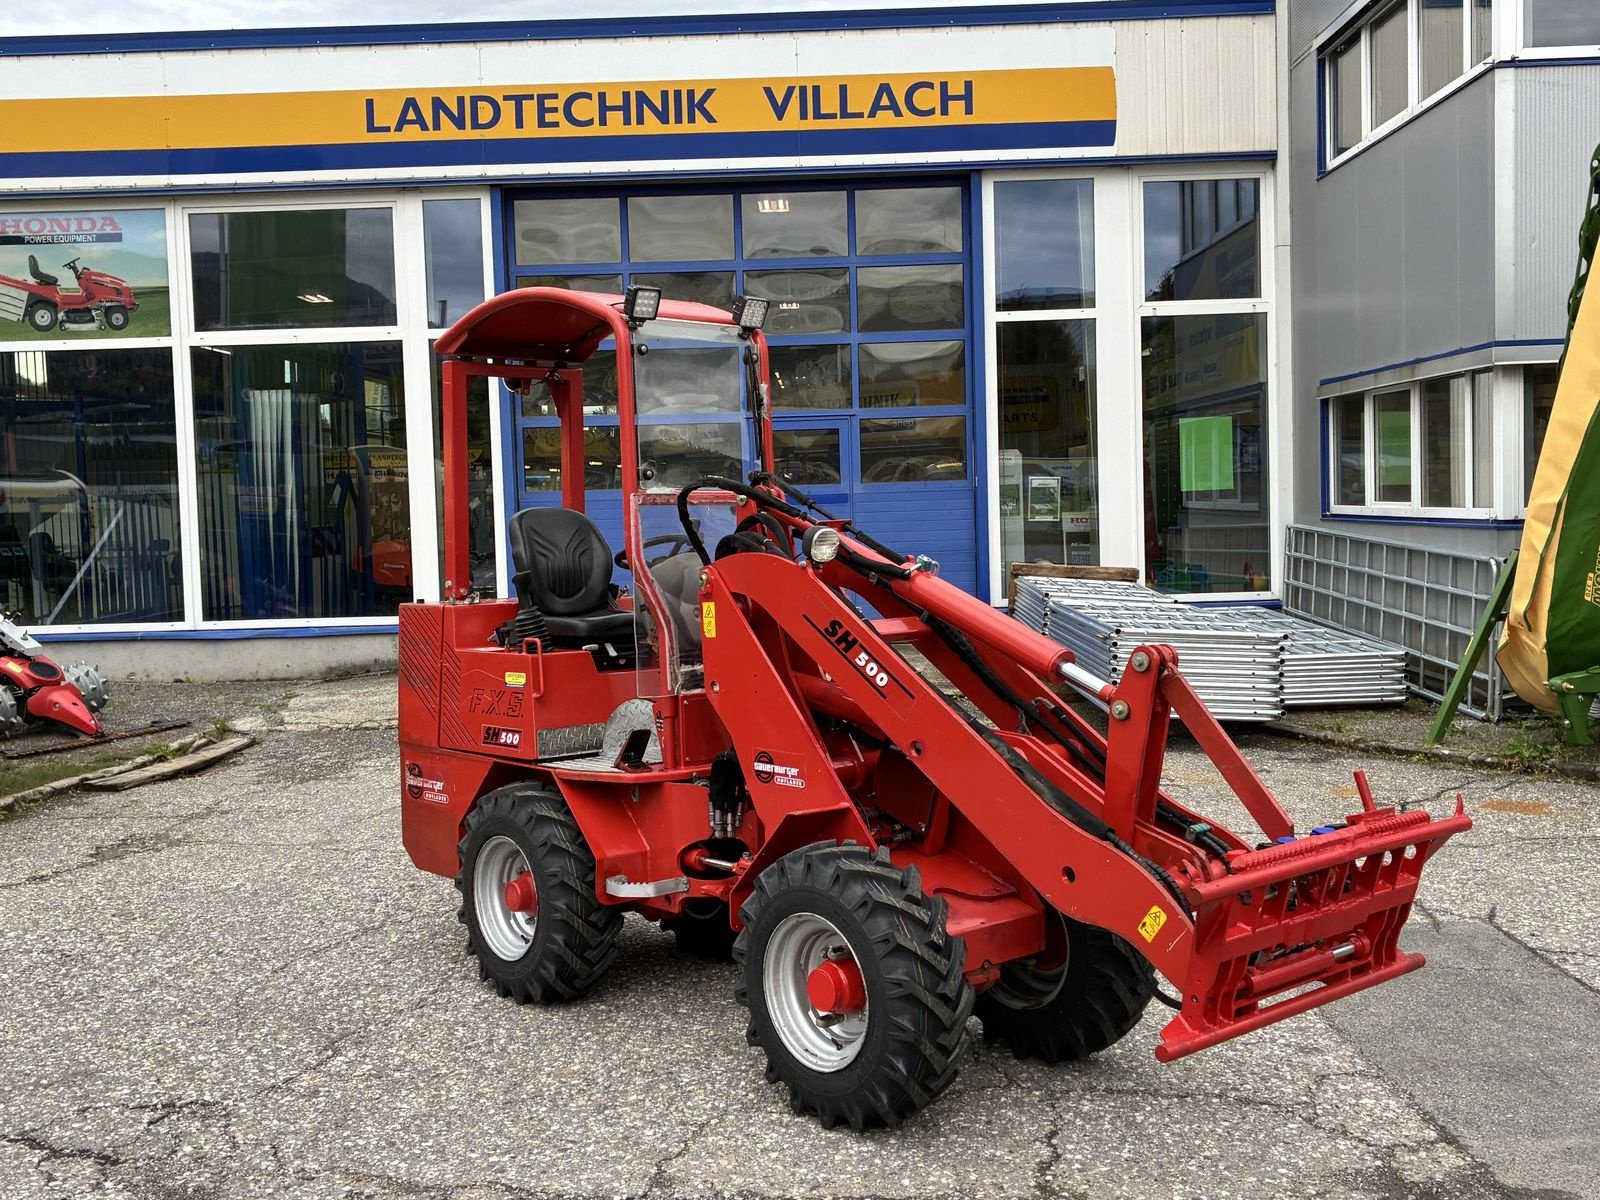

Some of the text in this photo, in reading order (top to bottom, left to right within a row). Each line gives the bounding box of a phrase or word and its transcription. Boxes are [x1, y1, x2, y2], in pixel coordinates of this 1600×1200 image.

[365, 80, 974, 133] LANDTECHNIK VILLACH
[0, 216, 122, 235] HONDA
[24, 234, 97, 244] POWER EQUIPMENT
[823, 619, 888, 687] SH 500
